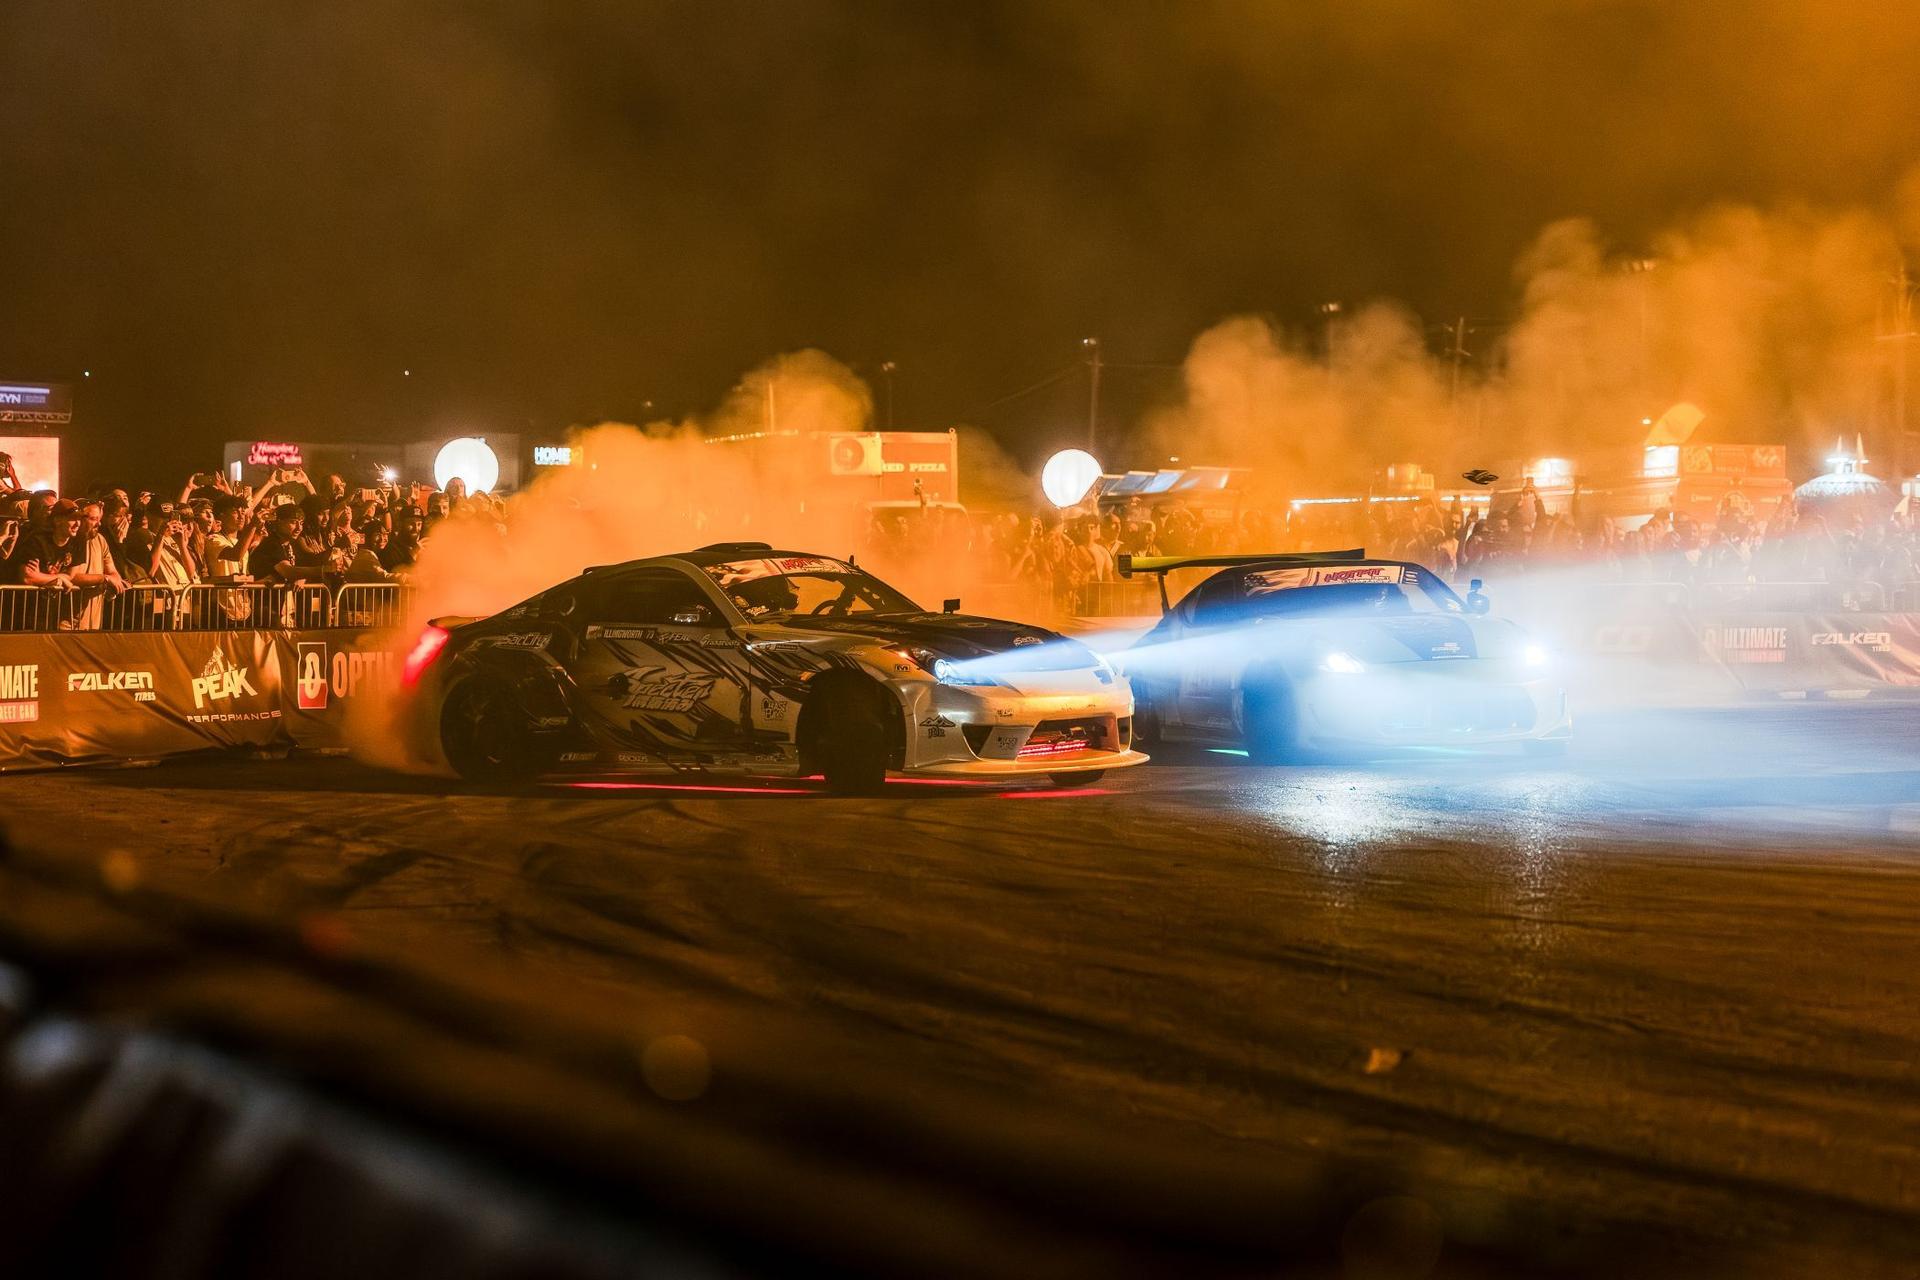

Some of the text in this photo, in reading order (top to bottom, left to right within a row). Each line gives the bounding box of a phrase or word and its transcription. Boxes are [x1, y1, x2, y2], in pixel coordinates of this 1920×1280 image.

[1724, 628, 1787, 649] ULTIMATE
[1812, 633, 1890, 645] FALKEN
[67, 672, 153, 691] FALKEN
[192, 667, 258, 709] PEAK
[187, 710, 281, 722] PERFORMANCE
